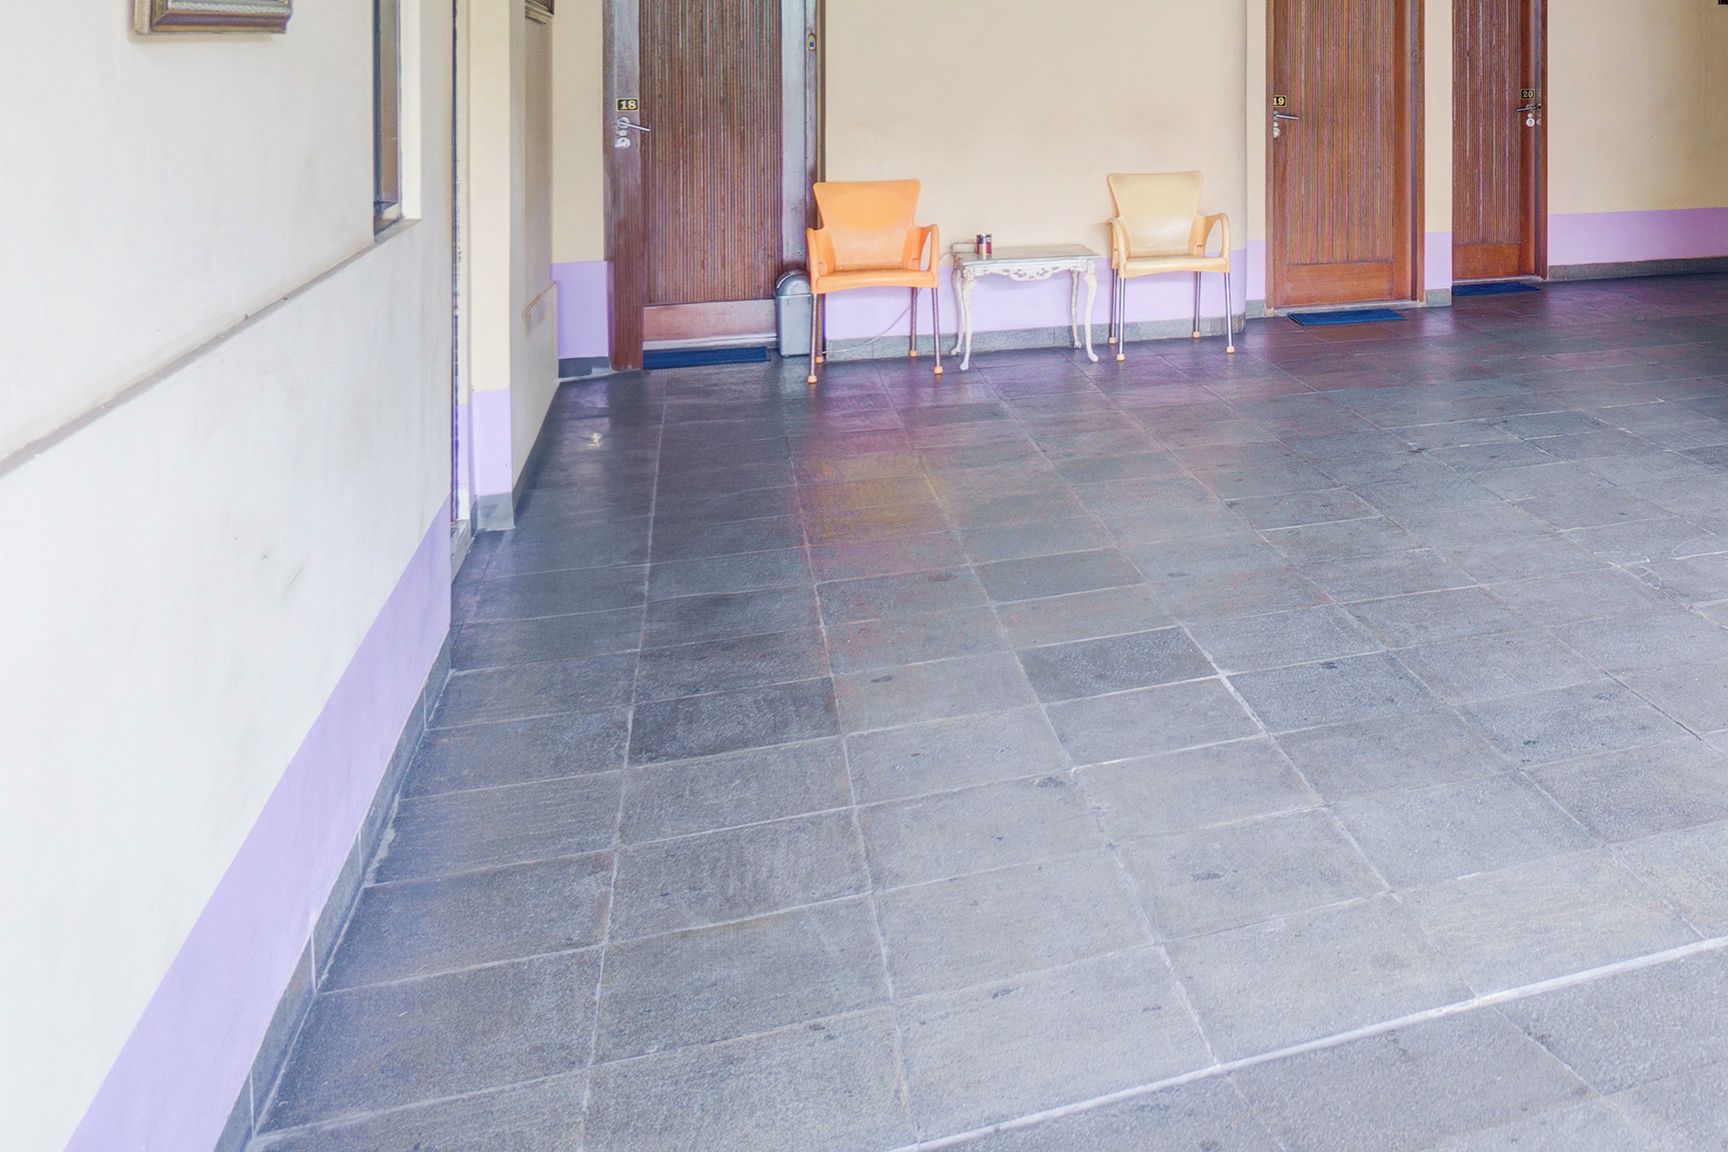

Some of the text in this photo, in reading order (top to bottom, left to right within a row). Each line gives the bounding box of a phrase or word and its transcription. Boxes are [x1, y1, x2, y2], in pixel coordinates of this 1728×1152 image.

[1522, 89, 1534, 98] 20
[620, 99, 637, 110] 18
[1273, 97, 1285, 106] 19
